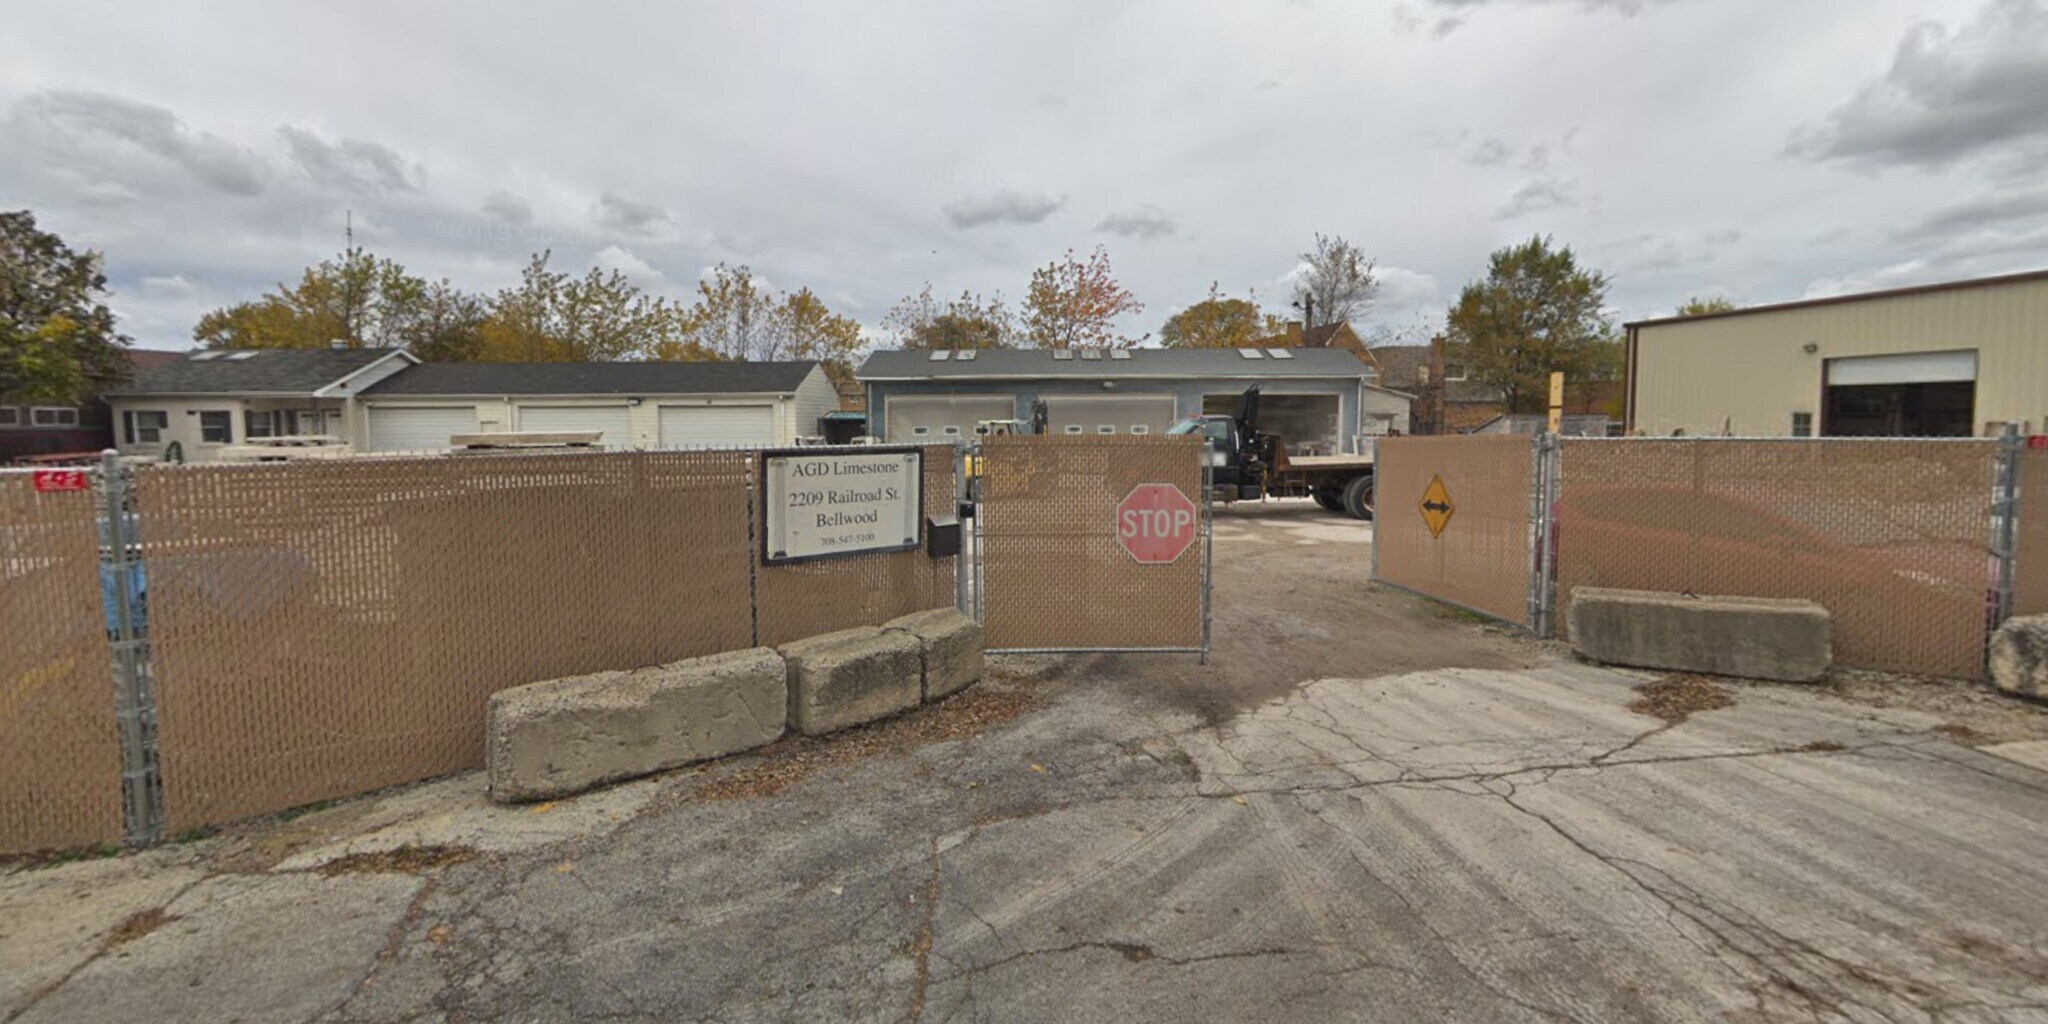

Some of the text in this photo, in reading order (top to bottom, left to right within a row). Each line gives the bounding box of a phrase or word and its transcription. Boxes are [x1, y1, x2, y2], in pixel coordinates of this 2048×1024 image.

[792, 460, 899, 477] AGD Limestone
[789, 487, 901, 507] 2209 Railroad St.
[816, 510, 878, 527] Bellwood
[1122, 509, 1191, 538] STOP
[821, 533, 875, 545] 708-547-5100
